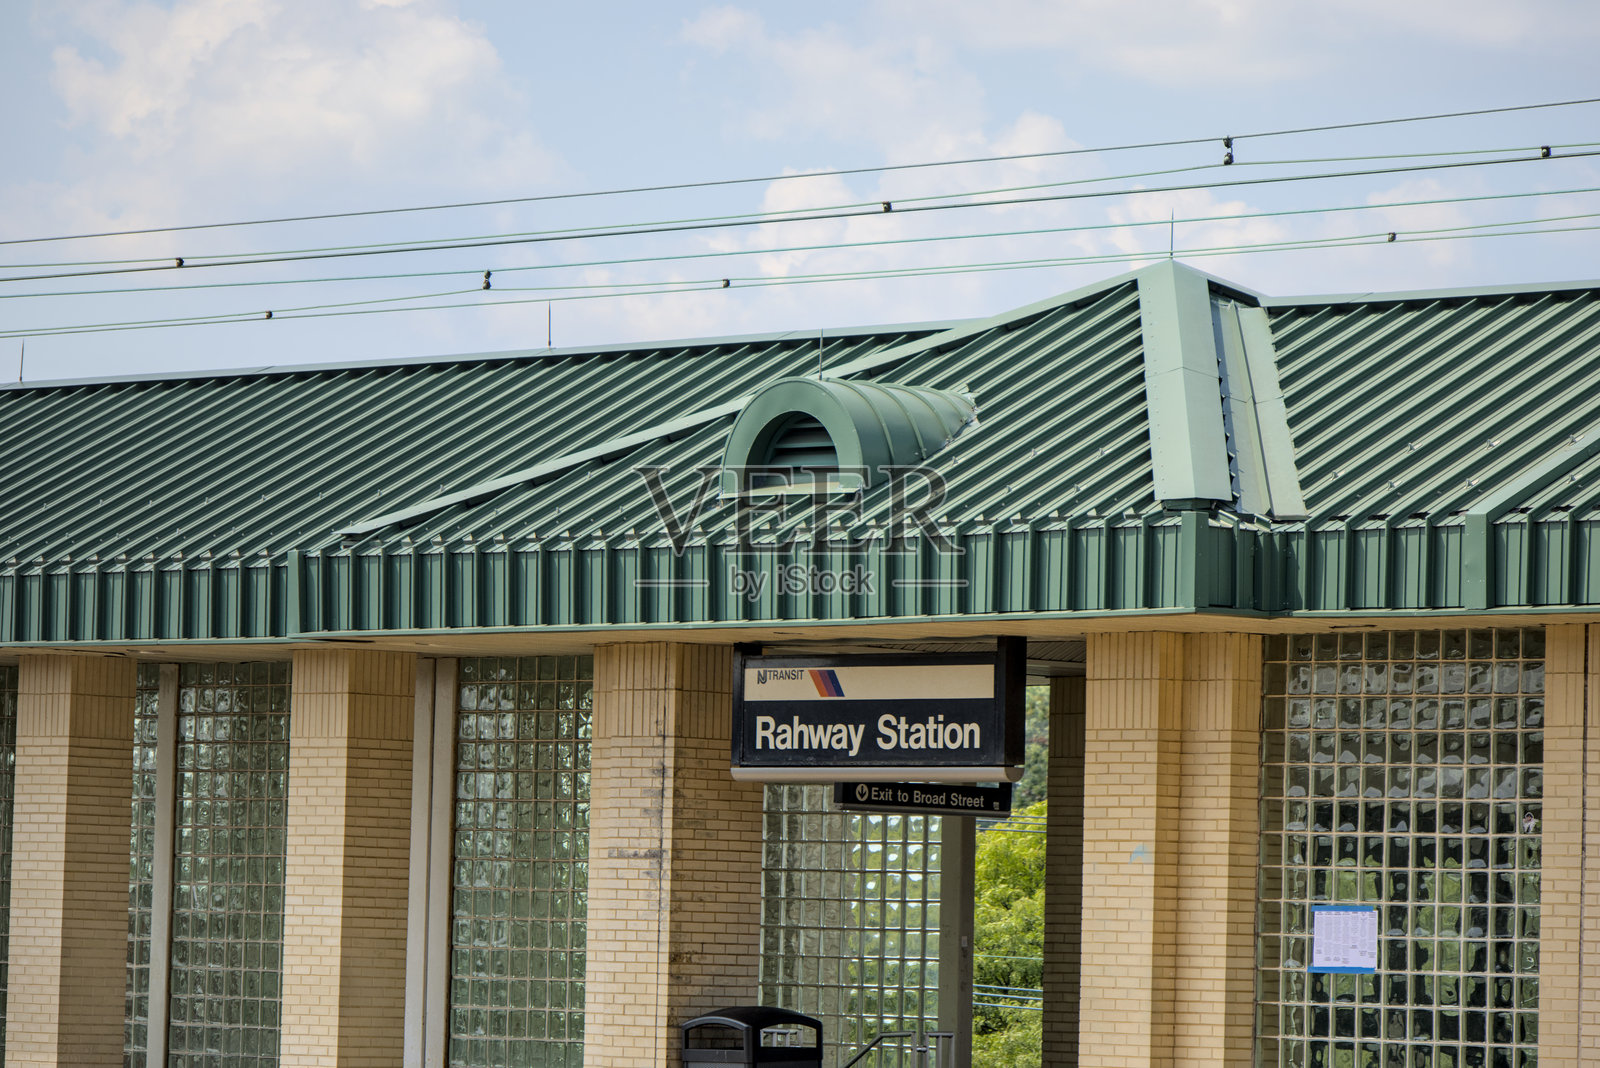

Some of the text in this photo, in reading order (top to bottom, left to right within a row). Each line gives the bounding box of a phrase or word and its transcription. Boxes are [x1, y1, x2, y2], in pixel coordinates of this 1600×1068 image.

[768, 669, 804, 680] TRANSIT
[755, 714, 981, 756] Rahway Station
[871, 787, 893, 801] Exit
[897, 789, 909, 802] to
[913, 790, 946, 805] Broad
[950, 792, 985, 808] Street
